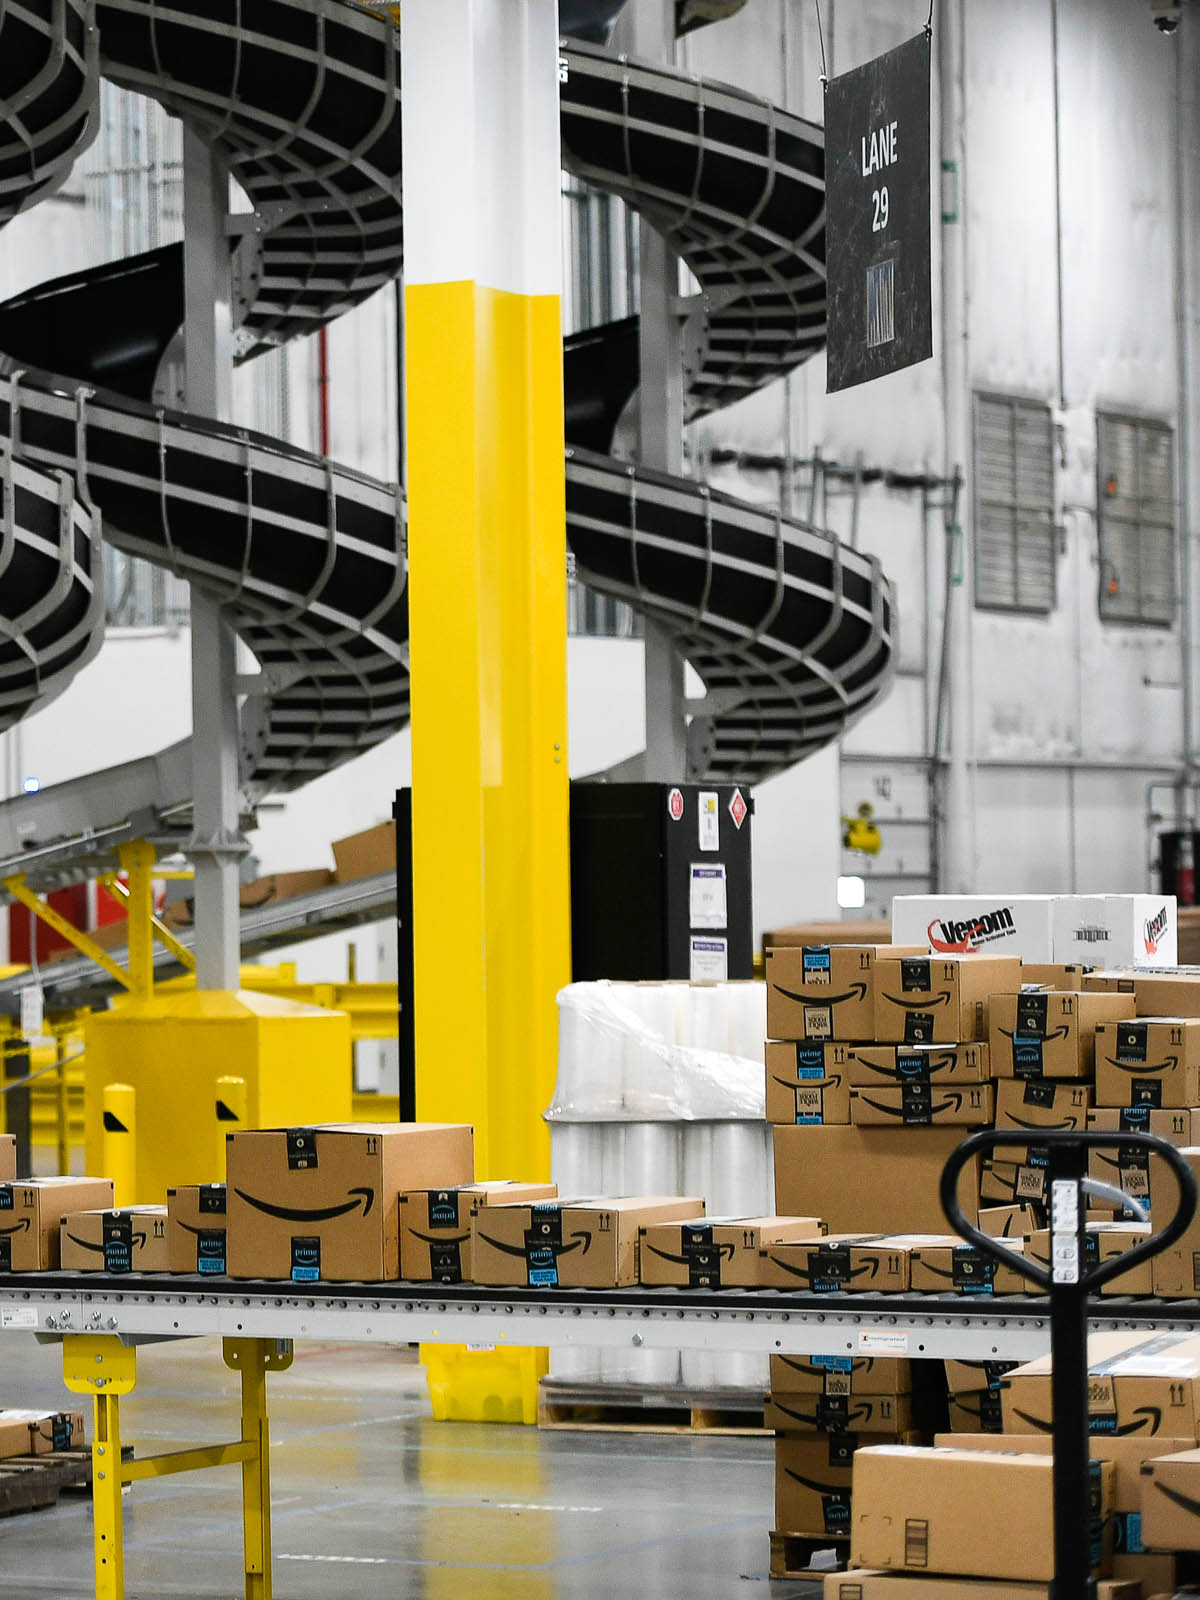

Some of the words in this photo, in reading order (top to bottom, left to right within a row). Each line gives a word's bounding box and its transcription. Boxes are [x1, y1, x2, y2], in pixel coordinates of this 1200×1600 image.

[862, 121, 897, 176] LANE
[872, 186, 888, 232] 29
[940, 907, 1013, 944] Venom
[800, 1050, 821, 1058] prime
[900, 1059, 921, 1067] prime
[1124, 1107, 1147, 1115] prime
[432, 1211, 455, 1220] prime
[201, 1239, 223, 1248] prime
[295, 1248, 318, 1257] prime
[530, 1251, 553, 1259] prime
